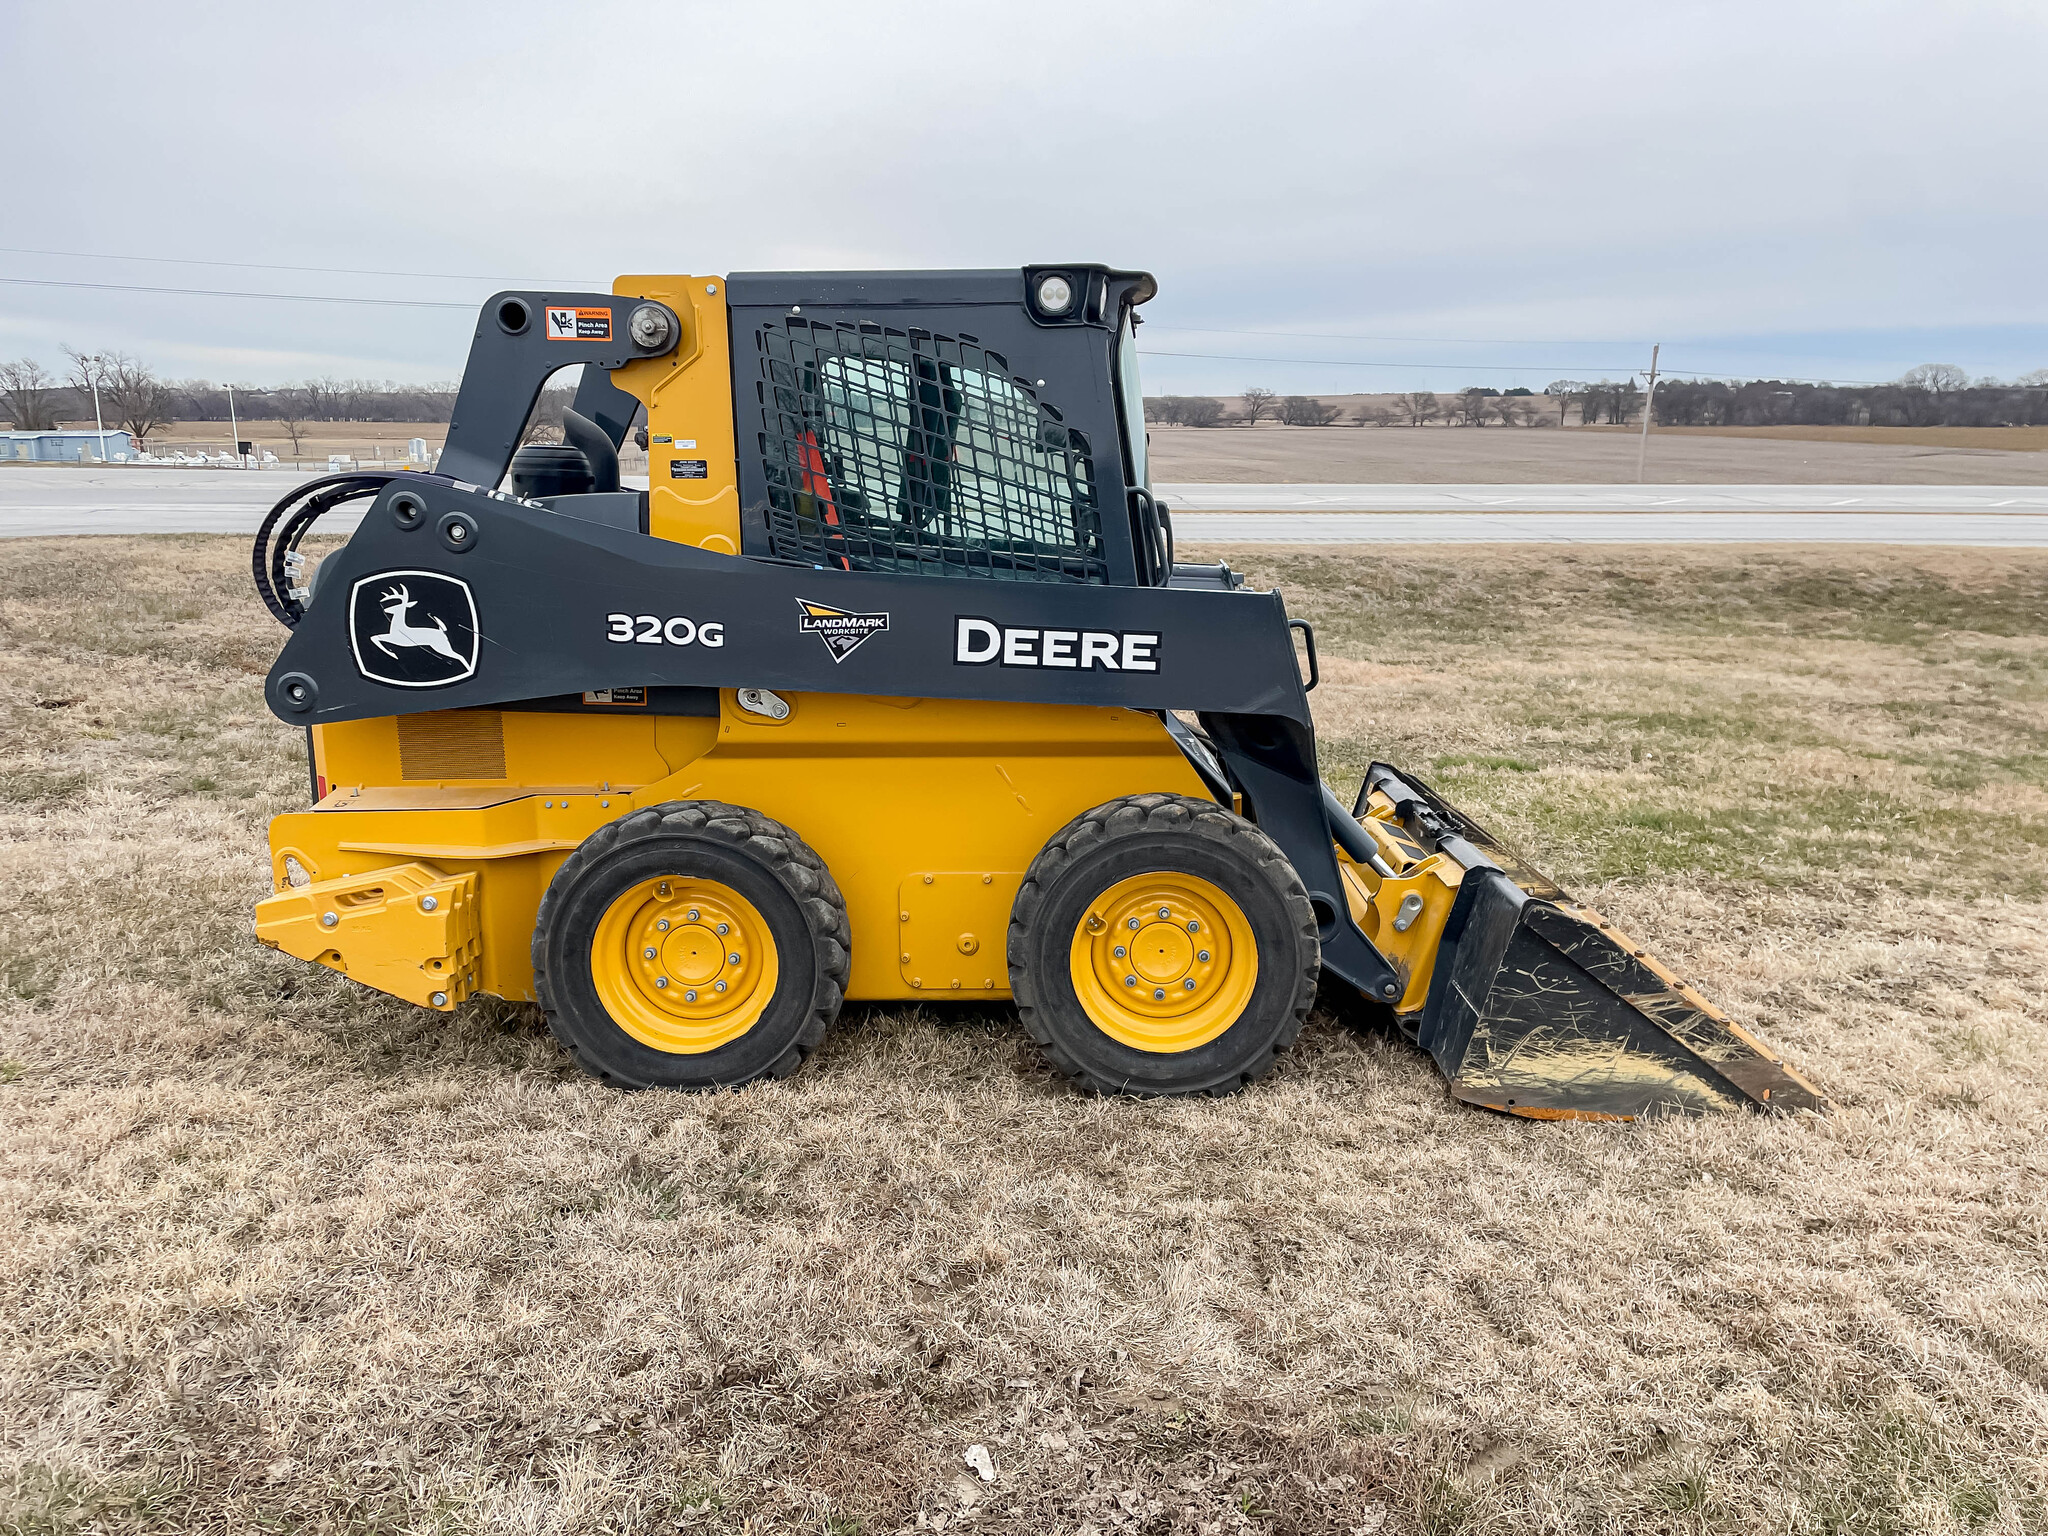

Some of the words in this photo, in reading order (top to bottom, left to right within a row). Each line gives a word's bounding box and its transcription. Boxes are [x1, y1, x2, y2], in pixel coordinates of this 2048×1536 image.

[606, 613, 725, 648] 320G
[803, 617, 886, 629] LANDMARK
[956, 618, 1159, 671] DEERE
